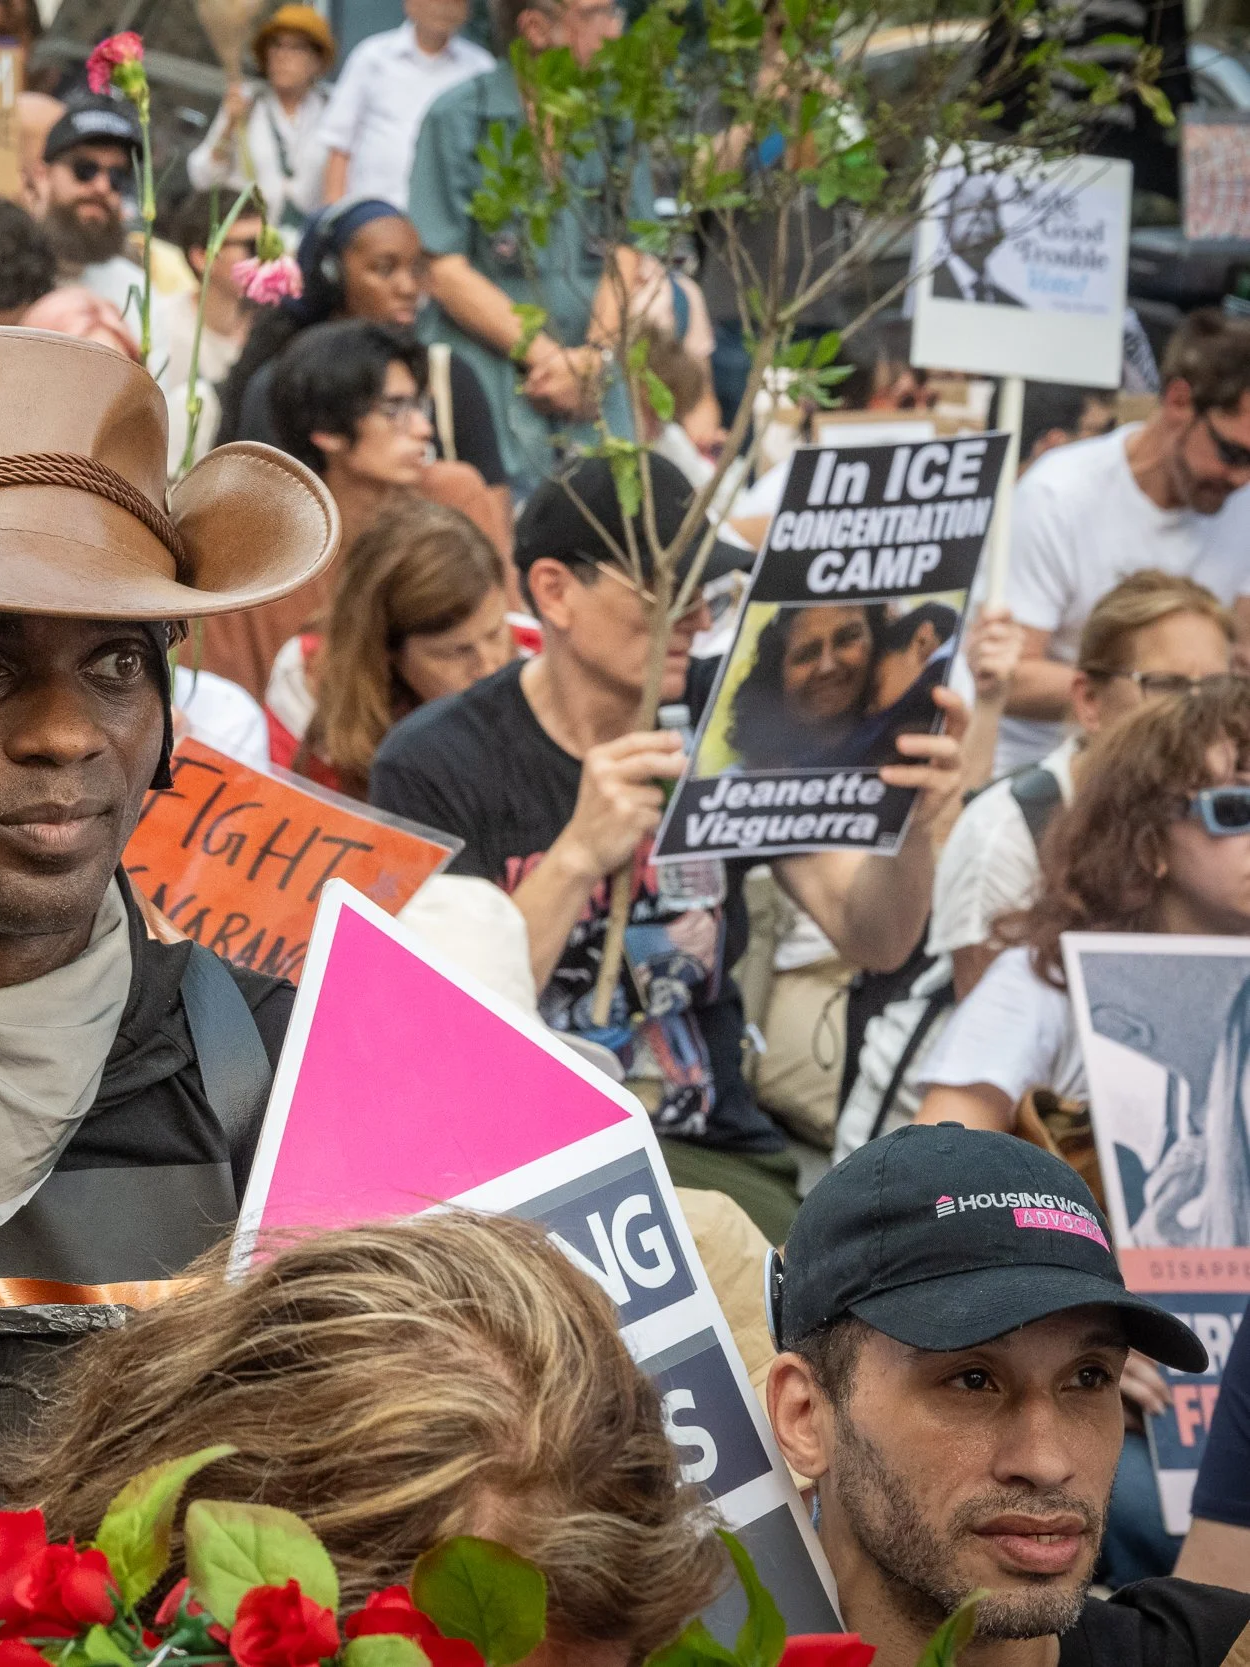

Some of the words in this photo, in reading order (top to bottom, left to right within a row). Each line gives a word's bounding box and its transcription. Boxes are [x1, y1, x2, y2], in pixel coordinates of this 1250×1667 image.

[807, 450, 871, 506] In
[883, 439, 988, 502] ICE
[770, 496, 993, 551] CONCENTRATION
[806, 543, 942, 594] CAMP
[700, 772, 886, 812] Jeanette
[686, 811, 879, 849] Vizguerra
